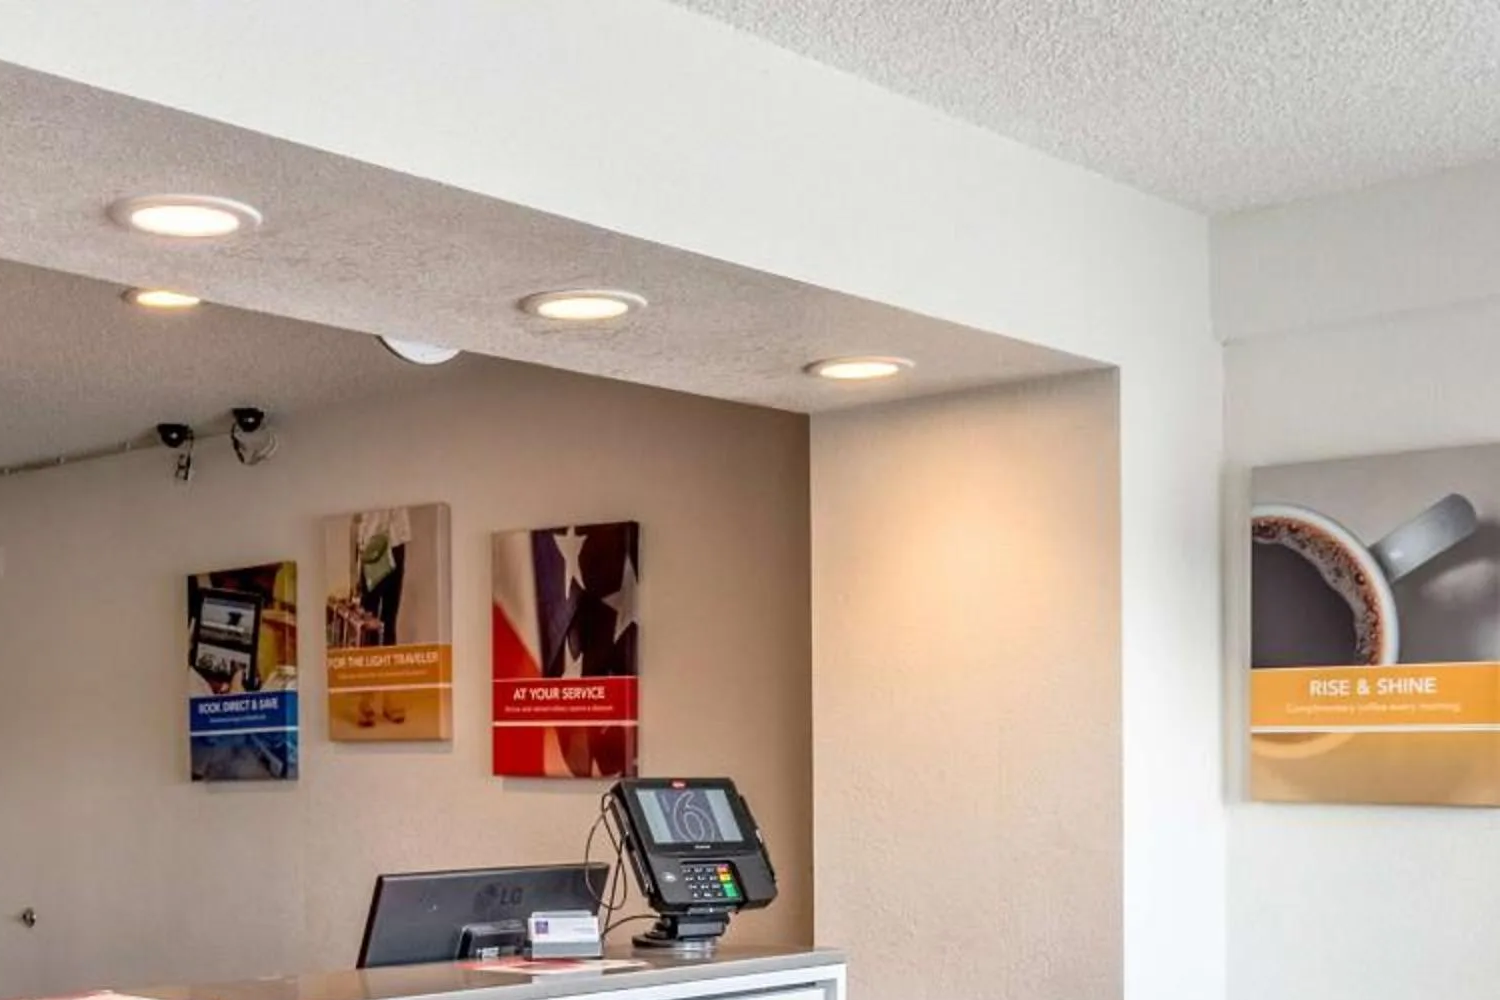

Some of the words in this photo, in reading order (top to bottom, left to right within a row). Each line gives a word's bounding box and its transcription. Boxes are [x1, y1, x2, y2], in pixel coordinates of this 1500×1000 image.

[513, 686, 527, 700] AT
[528, 686, 560, 700] YOUR
[562, 685, 605, 700] SERVICE
[1309, 679, 1350, 697] RISE
[1357, 678, 1370, 696] &
[1377, 676, 1437, 695] SHINE
[673, 790, 715, 841] 6
[500, 886, 524, 906] LG
